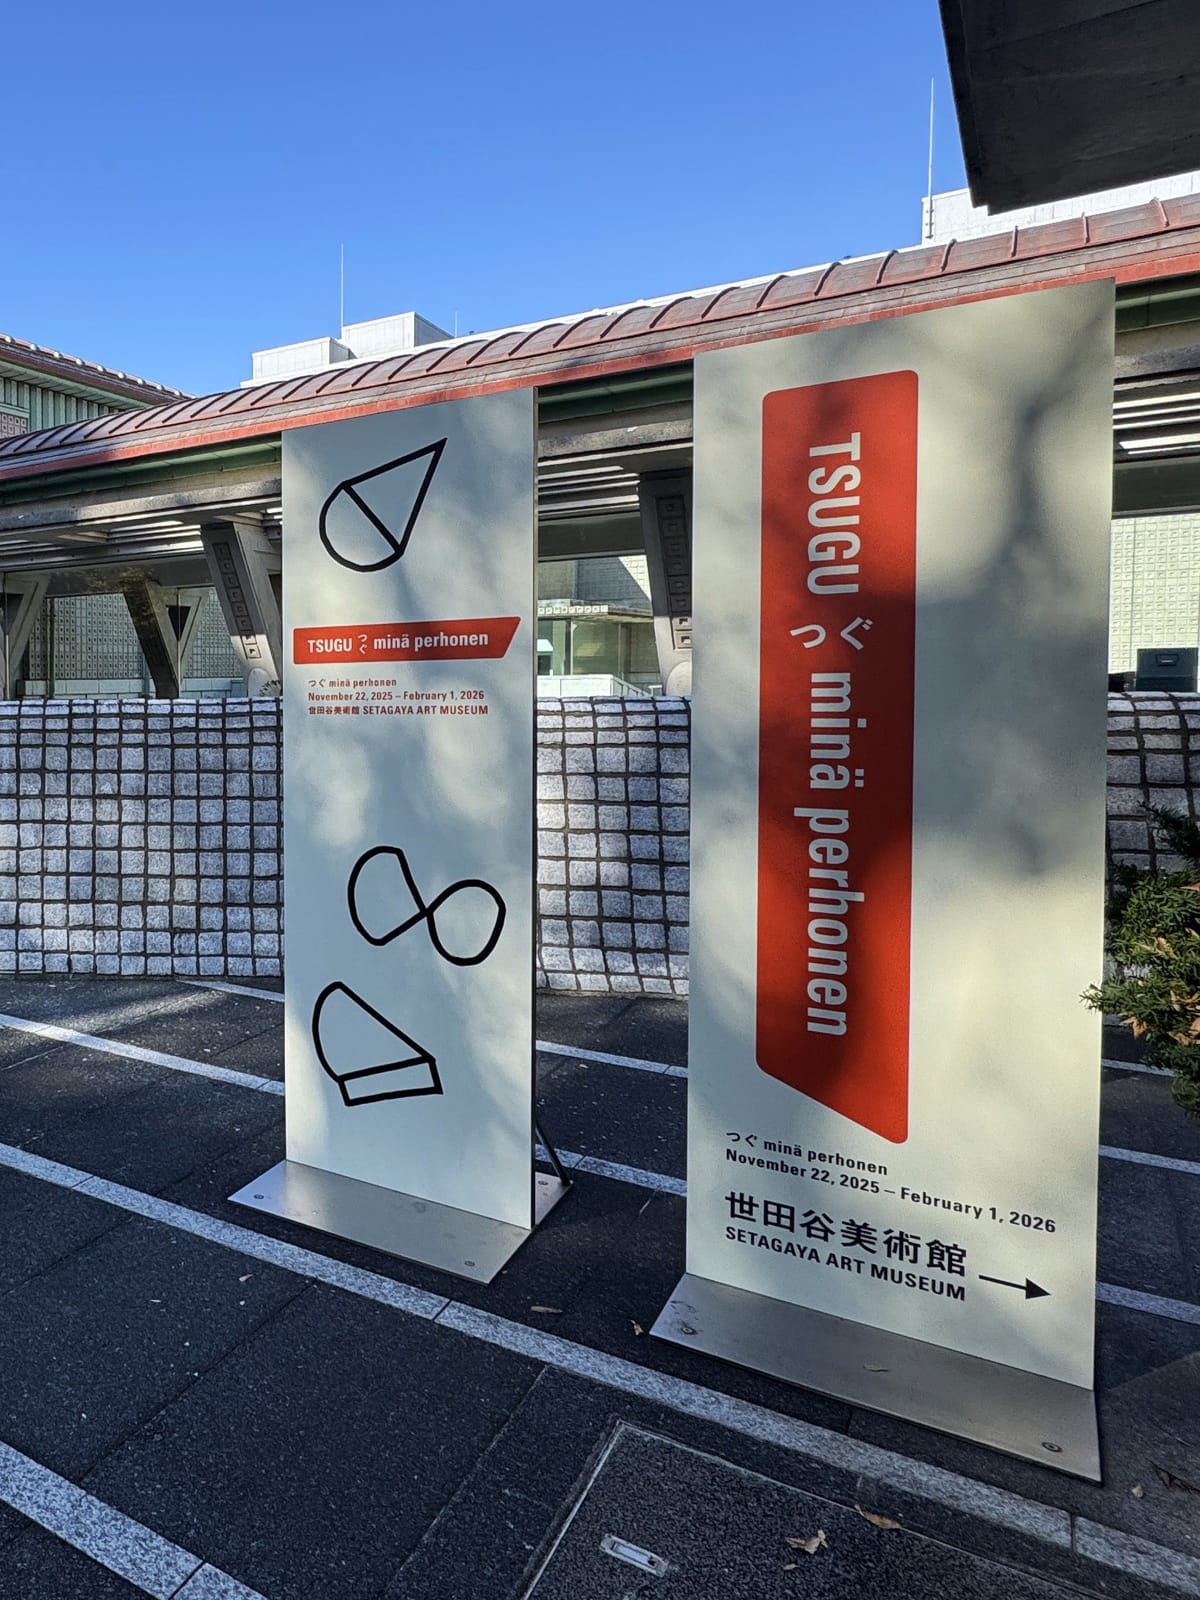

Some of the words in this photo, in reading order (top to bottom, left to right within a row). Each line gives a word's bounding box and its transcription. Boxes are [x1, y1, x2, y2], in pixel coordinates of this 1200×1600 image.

[806, 431, 861, 596] TSUGU
[307, 638, 353, 654] TSUGU
[373, 634, 410, 650] minä
[414, 631, 489, 652] perhonen
[308, 678, 326, 688] つぐ
[328, 678, 351, 688] minä
[353, 678, 397, 689] perhonen
[308, 692, 353, 701] November
[355, 691, 369, 702] 22,
[371, 691, 393, 701] 2025
[403, 690, 447, 702] February
[450, 690, 458, 701] 1,
[460, 690, 485, 700] 2026
[363, 705, 414, 715] SETAGAYA
[416, 705, 437, 715] ART
[440, 705, 489, 715] MUSEUM
[810, 671, 867, 791] minä
[794, 807, 865, 1036] perhonen
[726, 1131, 757, 1147] つぐ
[763, 1140, 802, 1157] minä
[807, 1149, 888, 1176] perhonen
[726, 1148, 807, 1177] November
[810, 1167, 835, 1185] 22,
[839, 1174, 880, 1194] 2025
[900, 1187, 983, 1220] February
[989, 1207, 1004, 1223] 1,
[1009, 1211, 1056, 1233] 2026
[724, 1191, 967, 1277] 世田谷美術館
[726, 1226, 820, 1264] SETAGAYA
[826, 1252, 865, 1274] ART
[870, 1263, 966, 1301] MUSEUM
